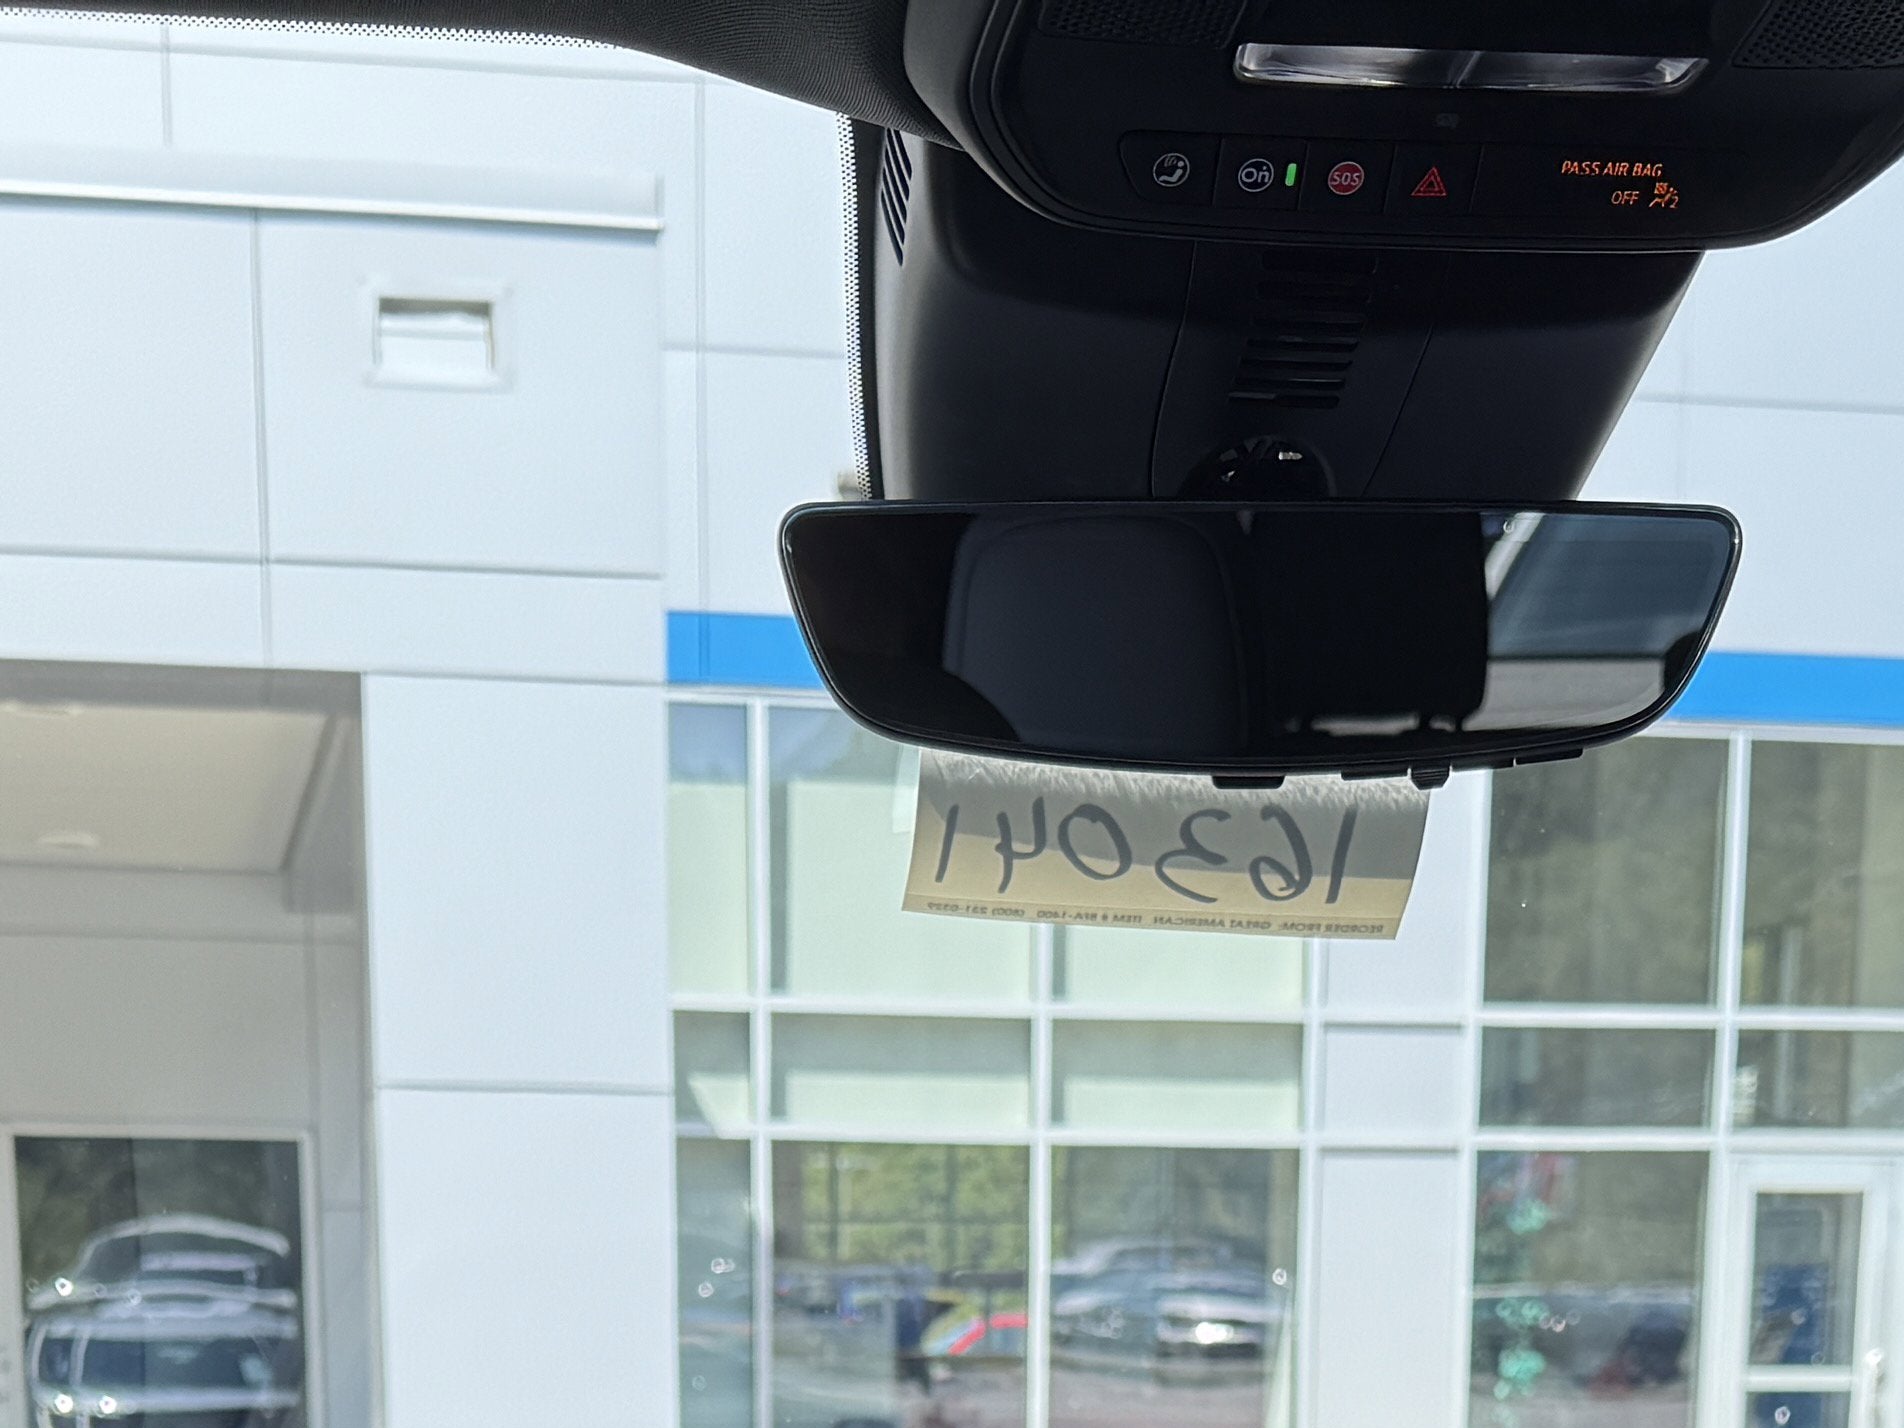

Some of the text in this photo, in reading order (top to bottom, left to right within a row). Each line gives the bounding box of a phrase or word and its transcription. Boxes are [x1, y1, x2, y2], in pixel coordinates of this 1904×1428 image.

[1561, 161, 1663, 177] PASS AIR BAG
[1332, 171, 1361, 186] SOS
[1611, 191, 1639, 205] OFF
